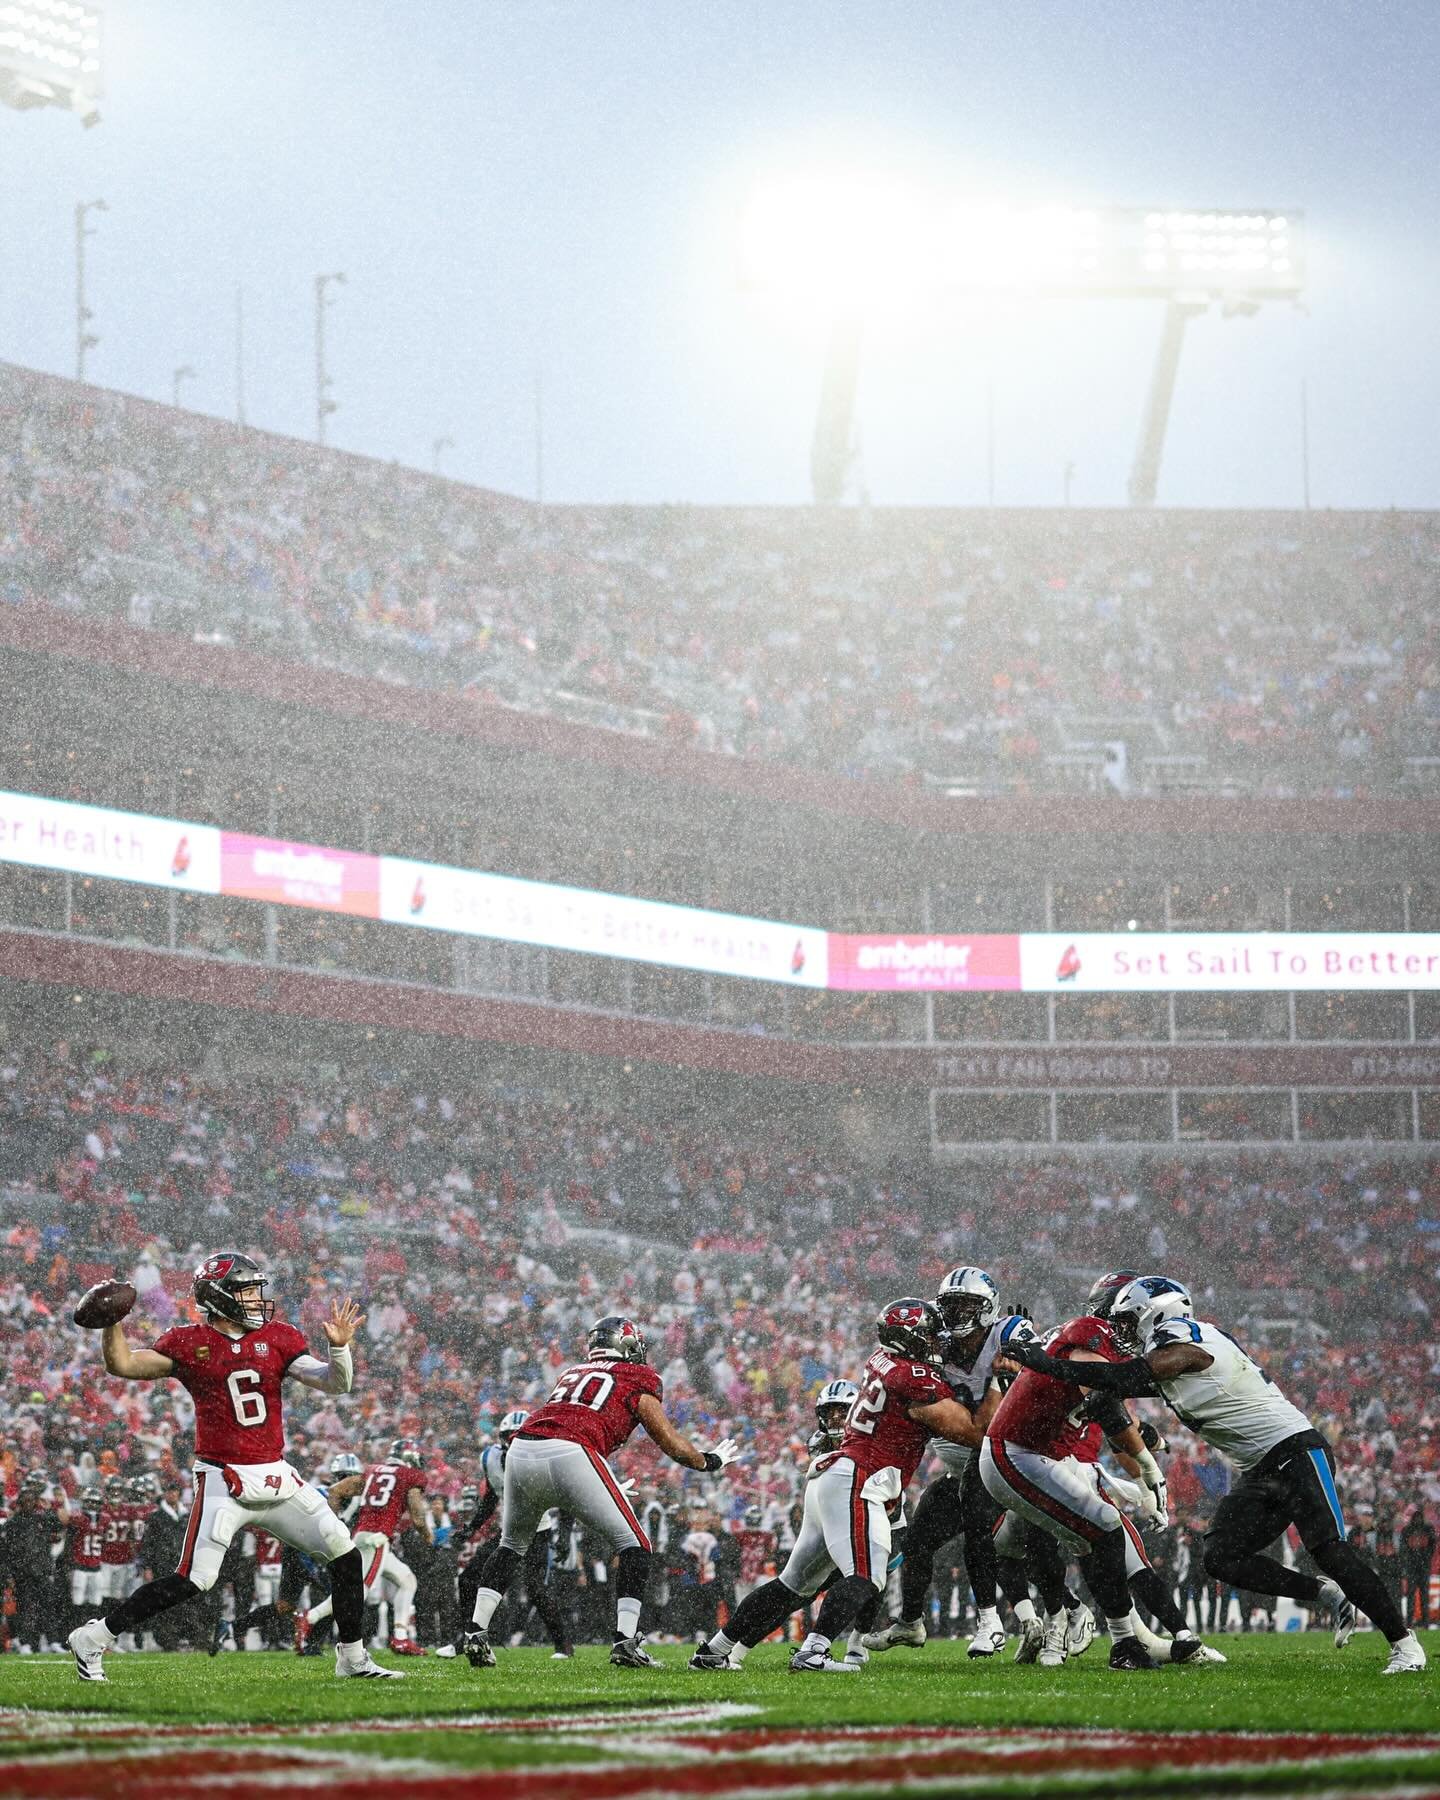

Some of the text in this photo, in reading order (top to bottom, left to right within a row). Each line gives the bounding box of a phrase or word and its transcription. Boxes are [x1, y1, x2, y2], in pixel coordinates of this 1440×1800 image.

[38, 818, 145, 864] Health
[1113, 948, 1440, 975] Set Sail To Better
[227, 1369, 267, 1427] 6
[549, 1371, 614, 1411] 60
[360, 1473, 397, 1507] 13
[83, 1534, 103, 1557] 15
[265, 1536, 280, 1559] 7
